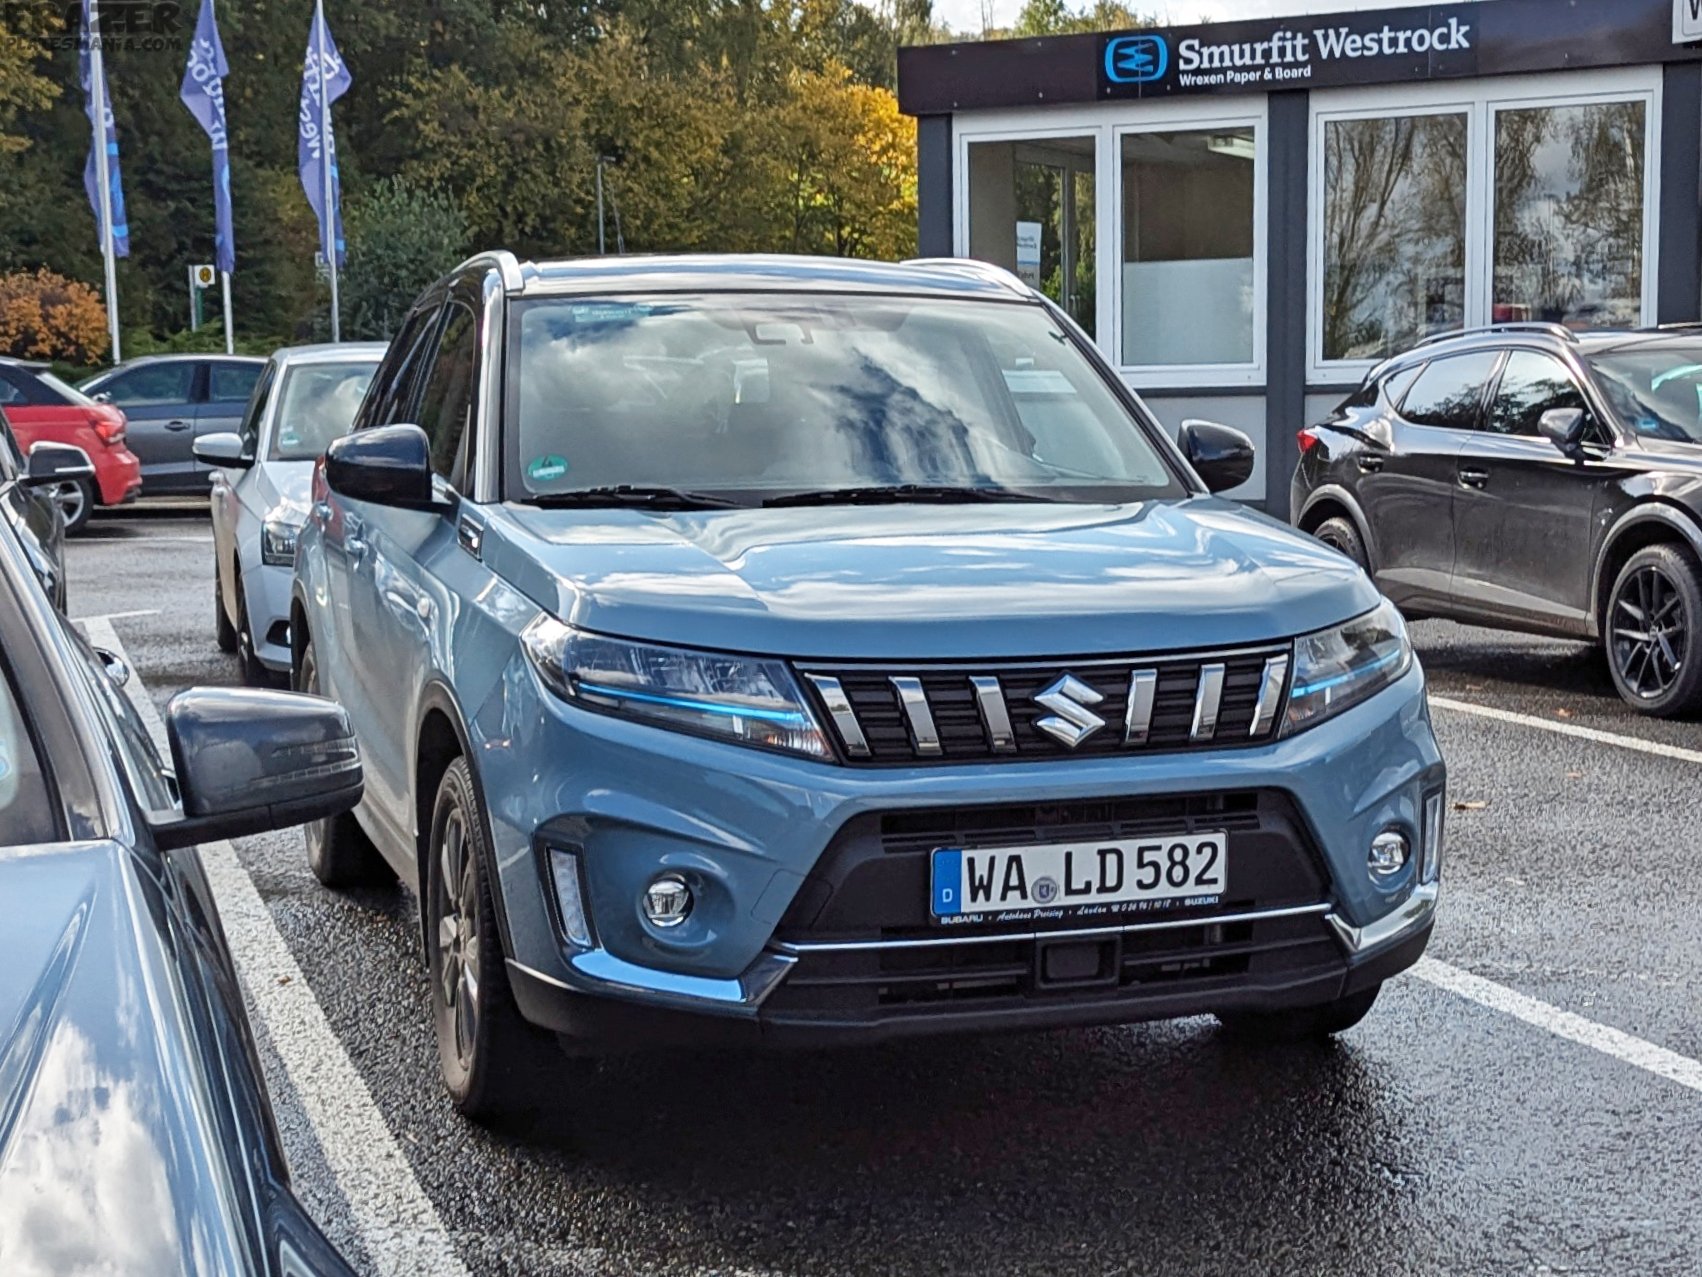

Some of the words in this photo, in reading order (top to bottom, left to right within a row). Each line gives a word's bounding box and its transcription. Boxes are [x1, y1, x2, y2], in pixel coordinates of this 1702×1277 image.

[1179, 31, 1309, 70] Smurfit
[1313, 17, 1470, 60] Westrock
[1180, 73, 1224, 86] Wrexen
[1226, 70, 1261, 85] Paper
[1263, 67, 1272, 80] &
[1275, 64, 1311, 80] Board
[942, 888, 953, 903] D
[967, 855, 1028, 903] WA
